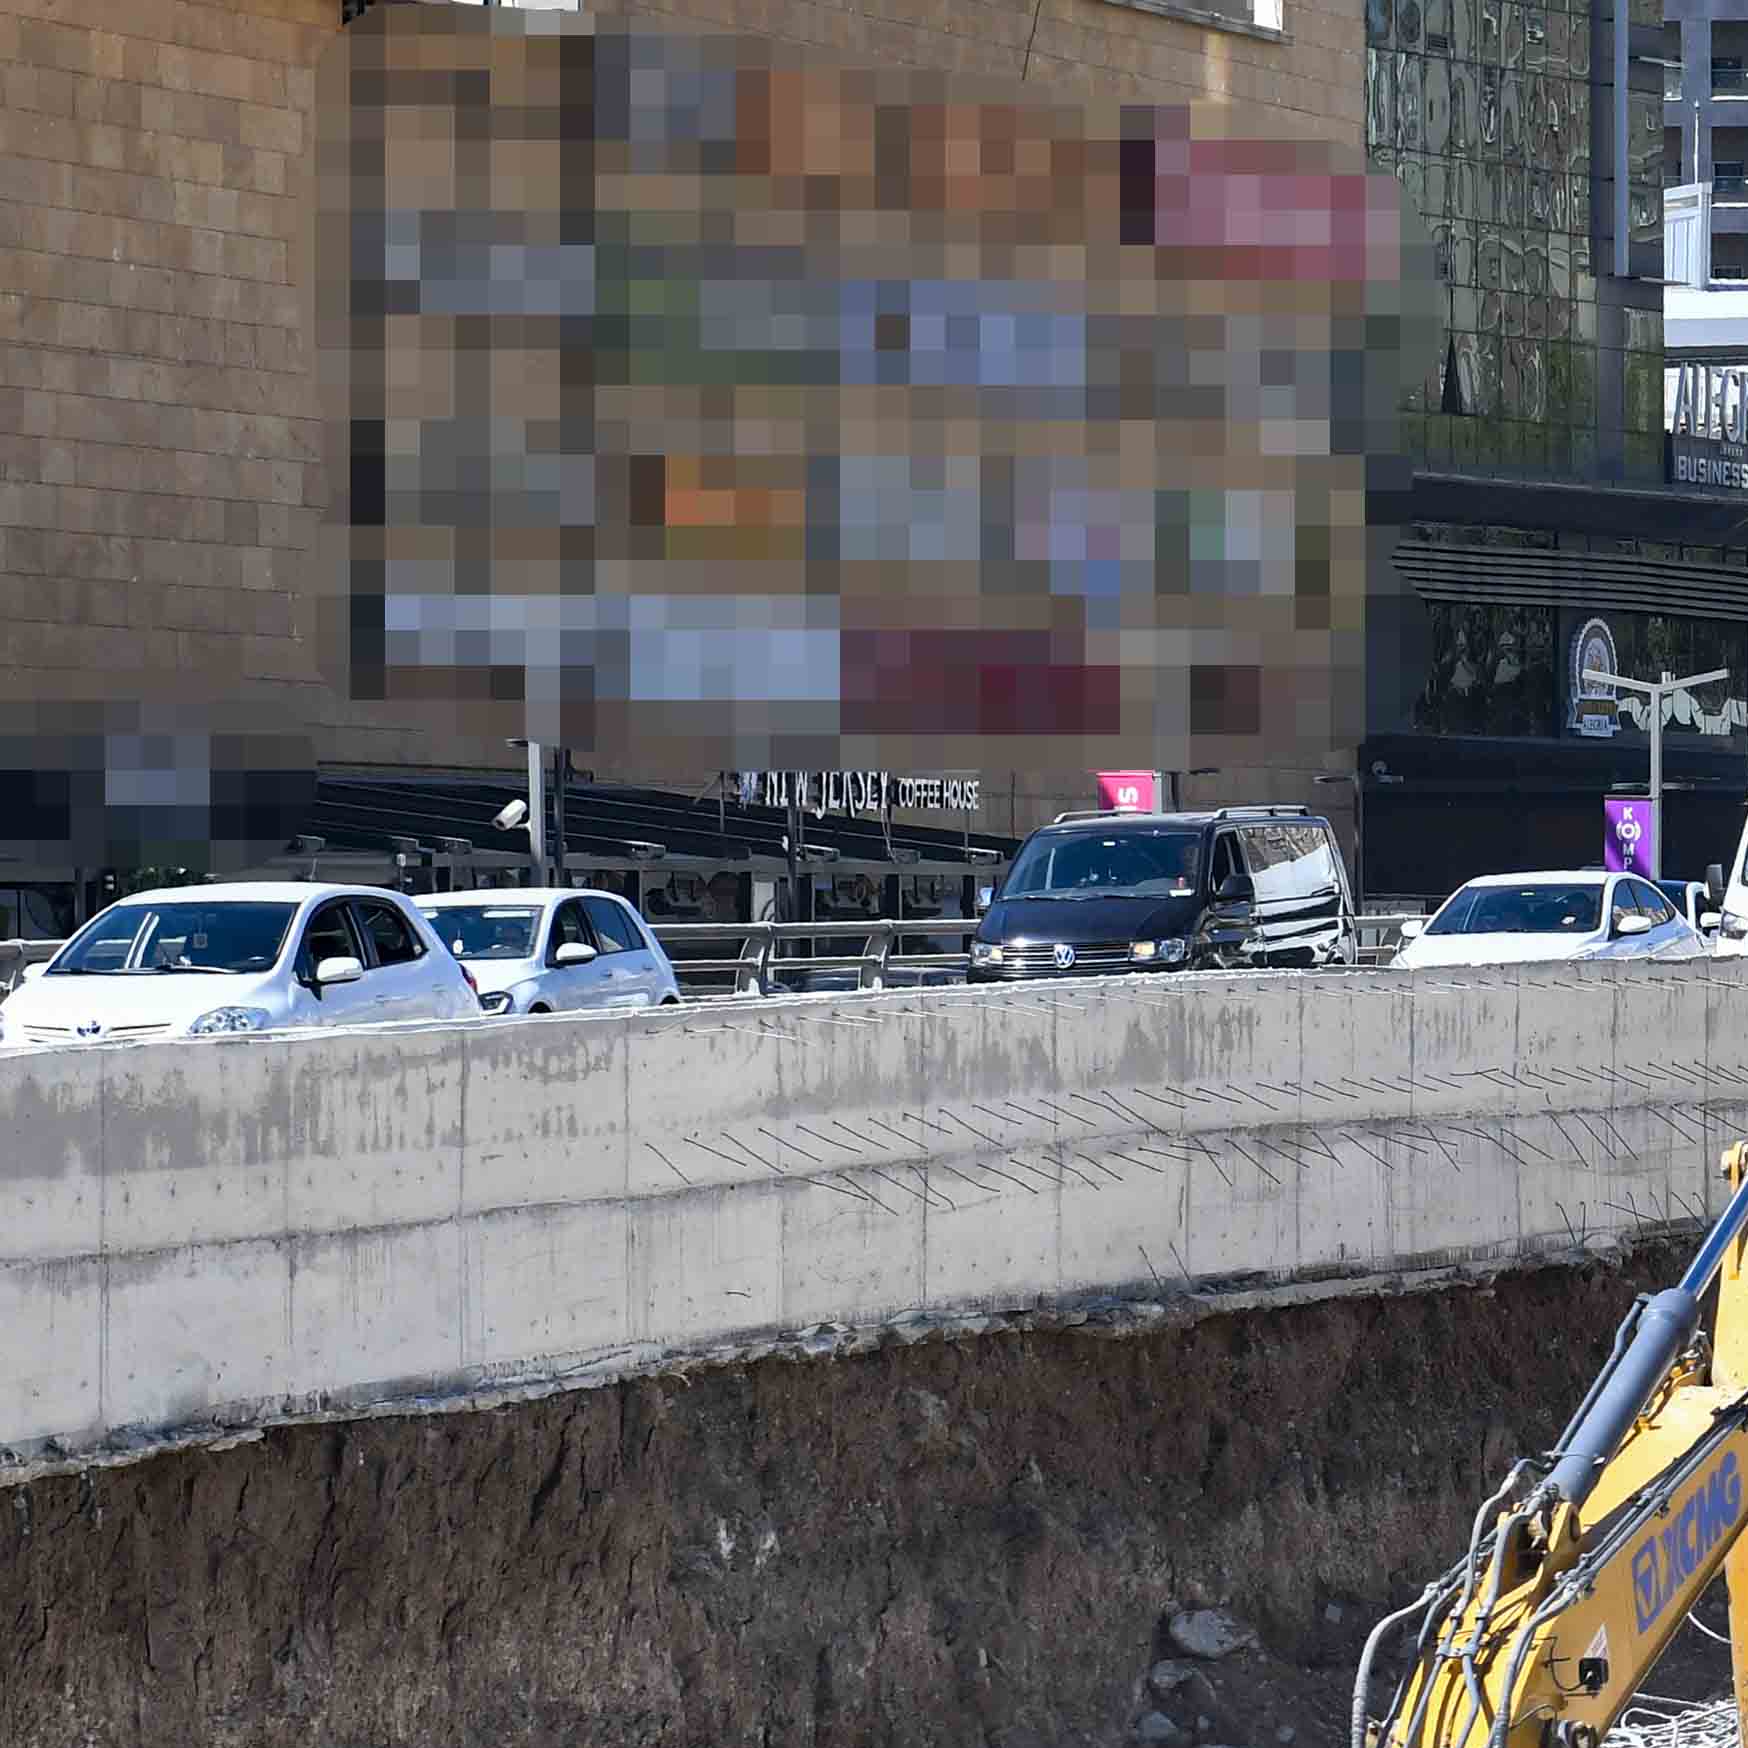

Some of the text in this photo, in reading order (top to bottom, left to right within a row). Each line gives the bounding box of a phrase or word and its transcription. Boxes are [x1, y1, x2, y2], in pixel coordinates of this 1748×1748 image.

[898, 778, 941, 808] COFFEE
[943, 778, 980, 810] HOUSE
[1658, 1449, 1742, 1604] XCMG
